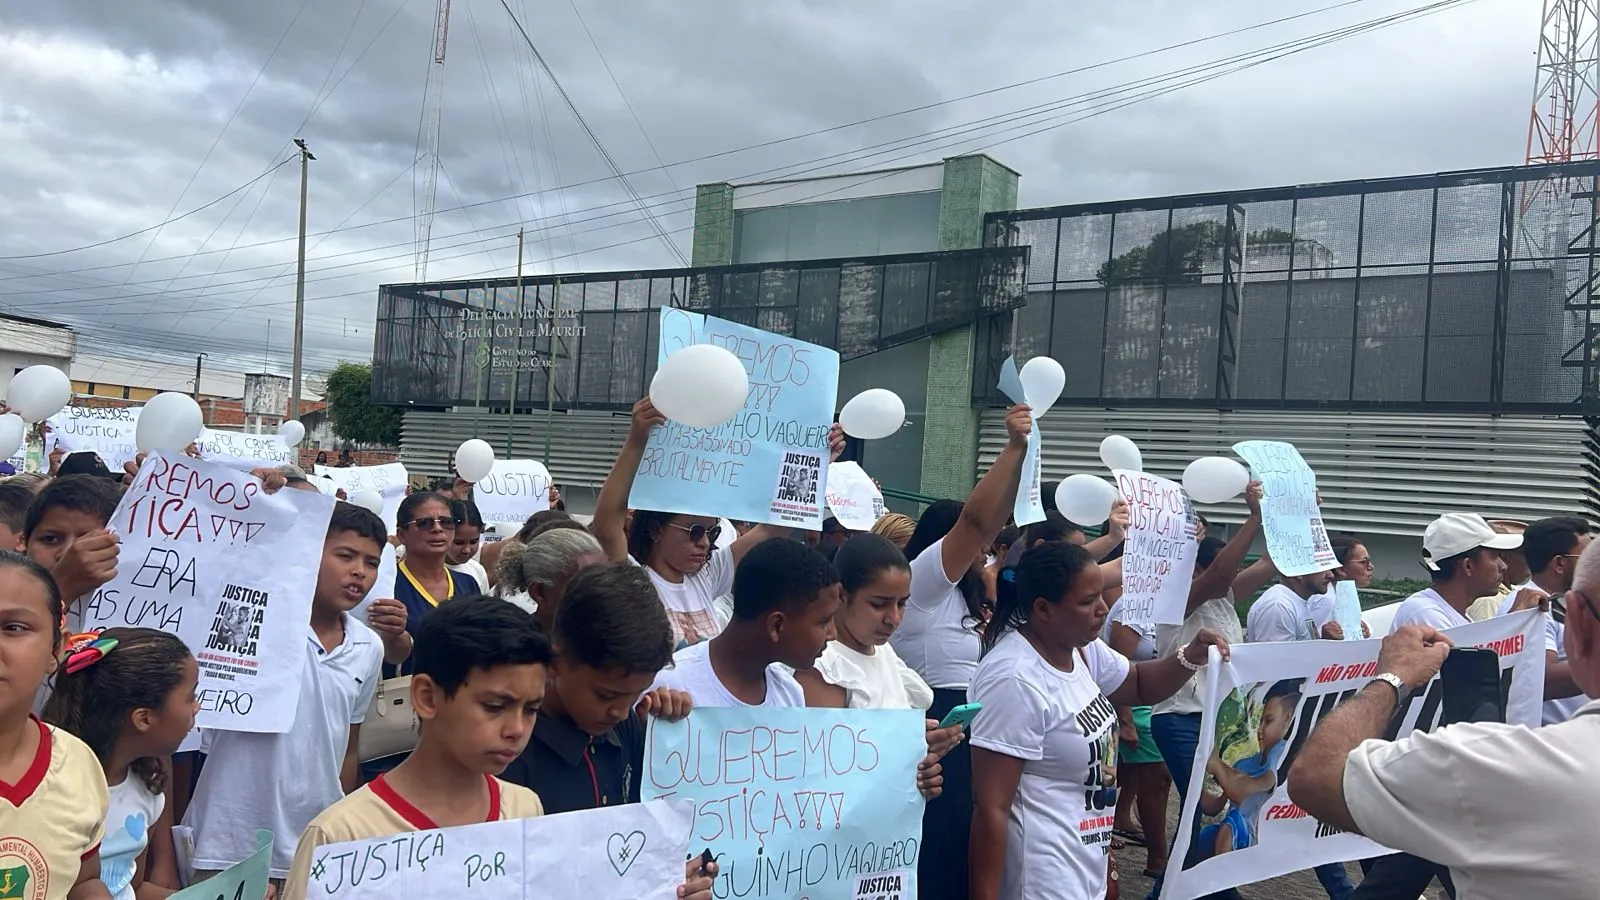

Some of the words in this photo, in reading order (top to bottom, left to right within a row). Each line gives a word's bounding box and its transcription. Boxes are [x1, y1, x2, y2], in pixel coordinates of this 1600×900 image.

[766, 416, 829, 448] VAQUEIR
[639, 447, 744, 487] BRUTALMENTE
[784, 452, 821, 468] JUSTIÇA
[1120, 474, 1183, 516] QUEREMOS
[131, 547, 196, 597] ERA
[124, 596, 183, 632] UMA
[222, 583, 269, 607] JUSTIÇA
[1315, 664, 1345, 684] NÃO
[1340, 663, 1366, 680] FOI
[650, 715, 879, 789] QUEREMOS
[27, 849, 46, 891] HUMBERTO
[464, 850, 506, 888] POR
[833, 837, 917, 881] VAQUEIRO
[857, 876, 902, 896] JUSTIÇA
